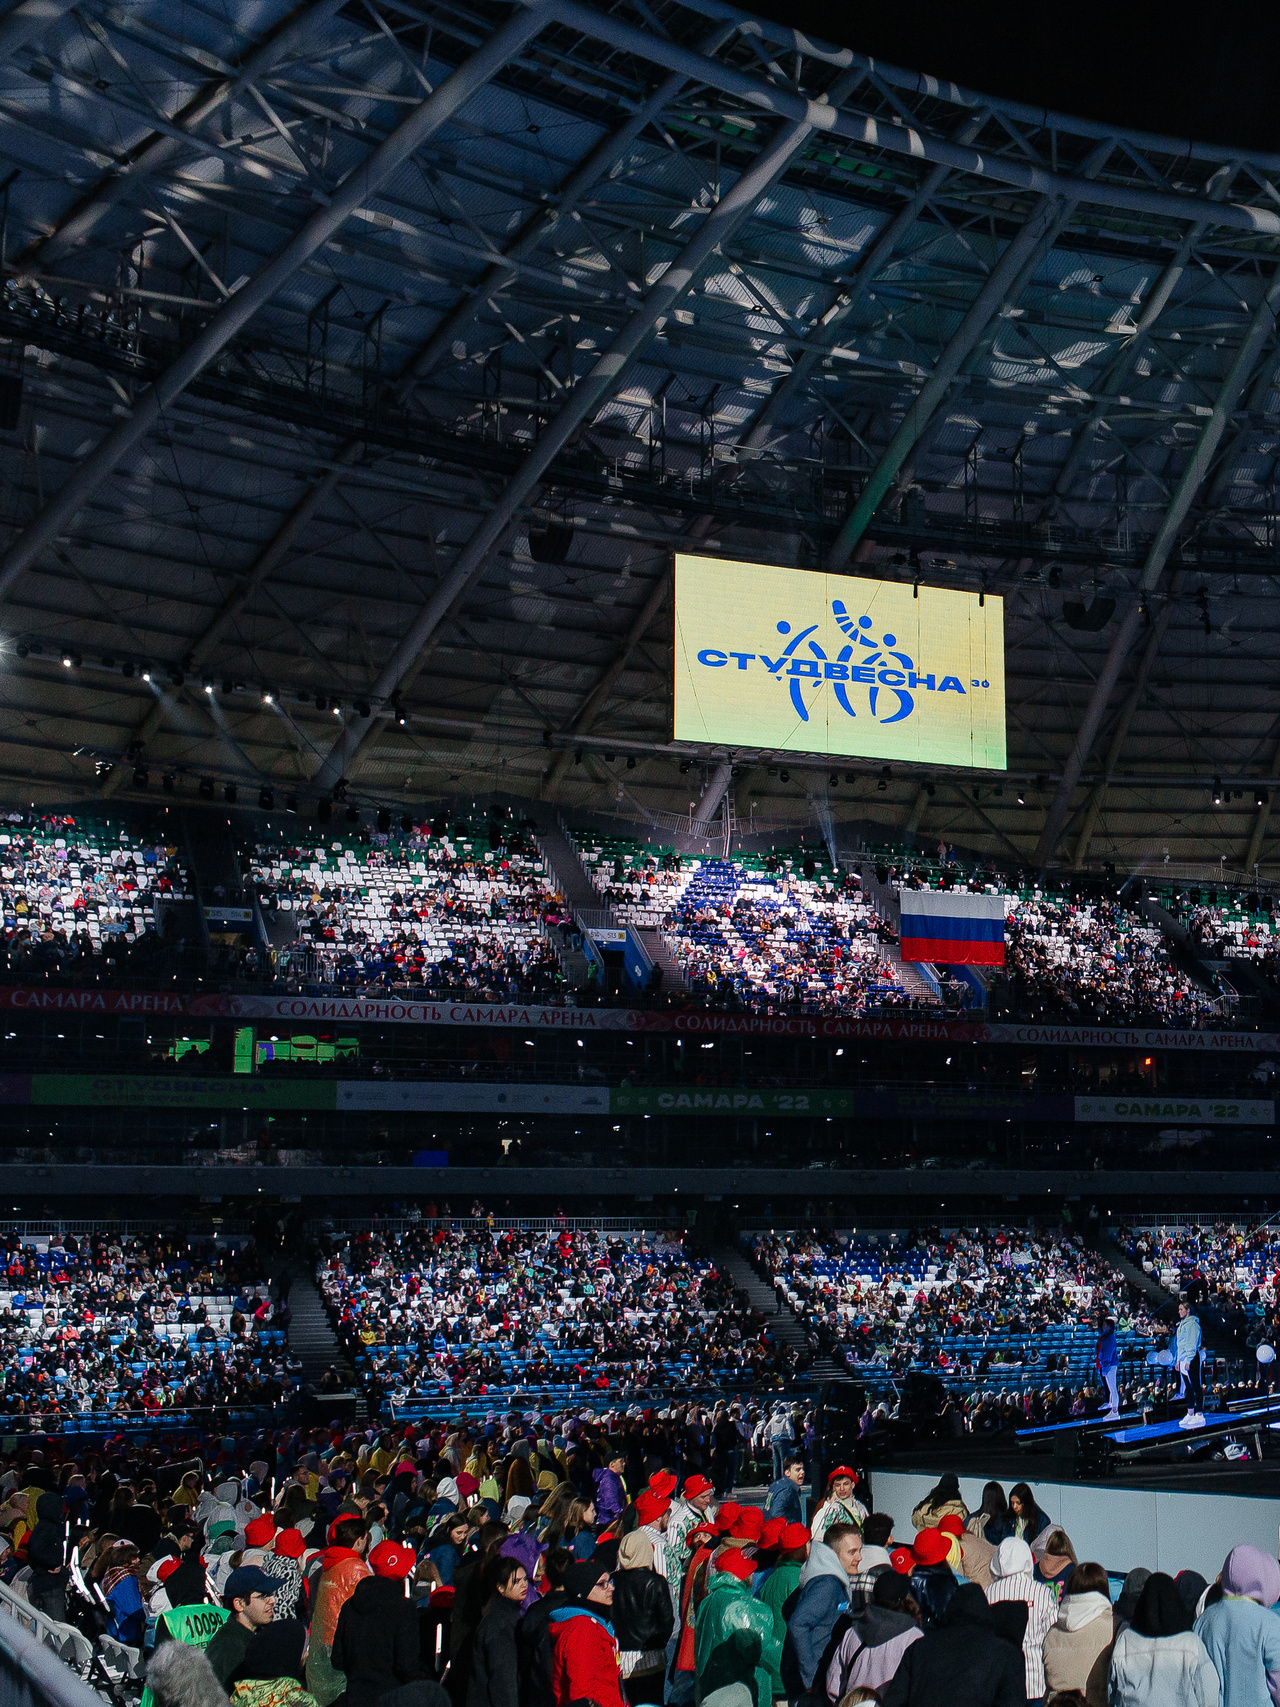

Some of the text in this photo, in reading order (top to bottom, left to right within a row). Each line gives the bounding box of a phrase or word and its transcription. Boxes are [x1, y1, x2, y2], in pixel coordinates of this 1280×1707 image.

[697, 648, 990, 695] СТУДВЕСНА 30
[10, 990, 184, 1012] САМАРА АРЕНА
[276, 1000, 596, 1027] СОЛИДАРНОСТЬ САМАРА АРЕНА
[674, 1014, 949, 1039] СОЛИДАРНОСТЬ САМАРА АРЕНА
[1016, 1028, 1255, 1049] СОЛИДАРНОСТЬ САМАРА АРЕНА
[92, 1079, 267, 1094] СТУДВЕСНА
[658, 1092, 765, 1109] САМАРА
[1114, 1102, 1203, 1118] САМАРА
